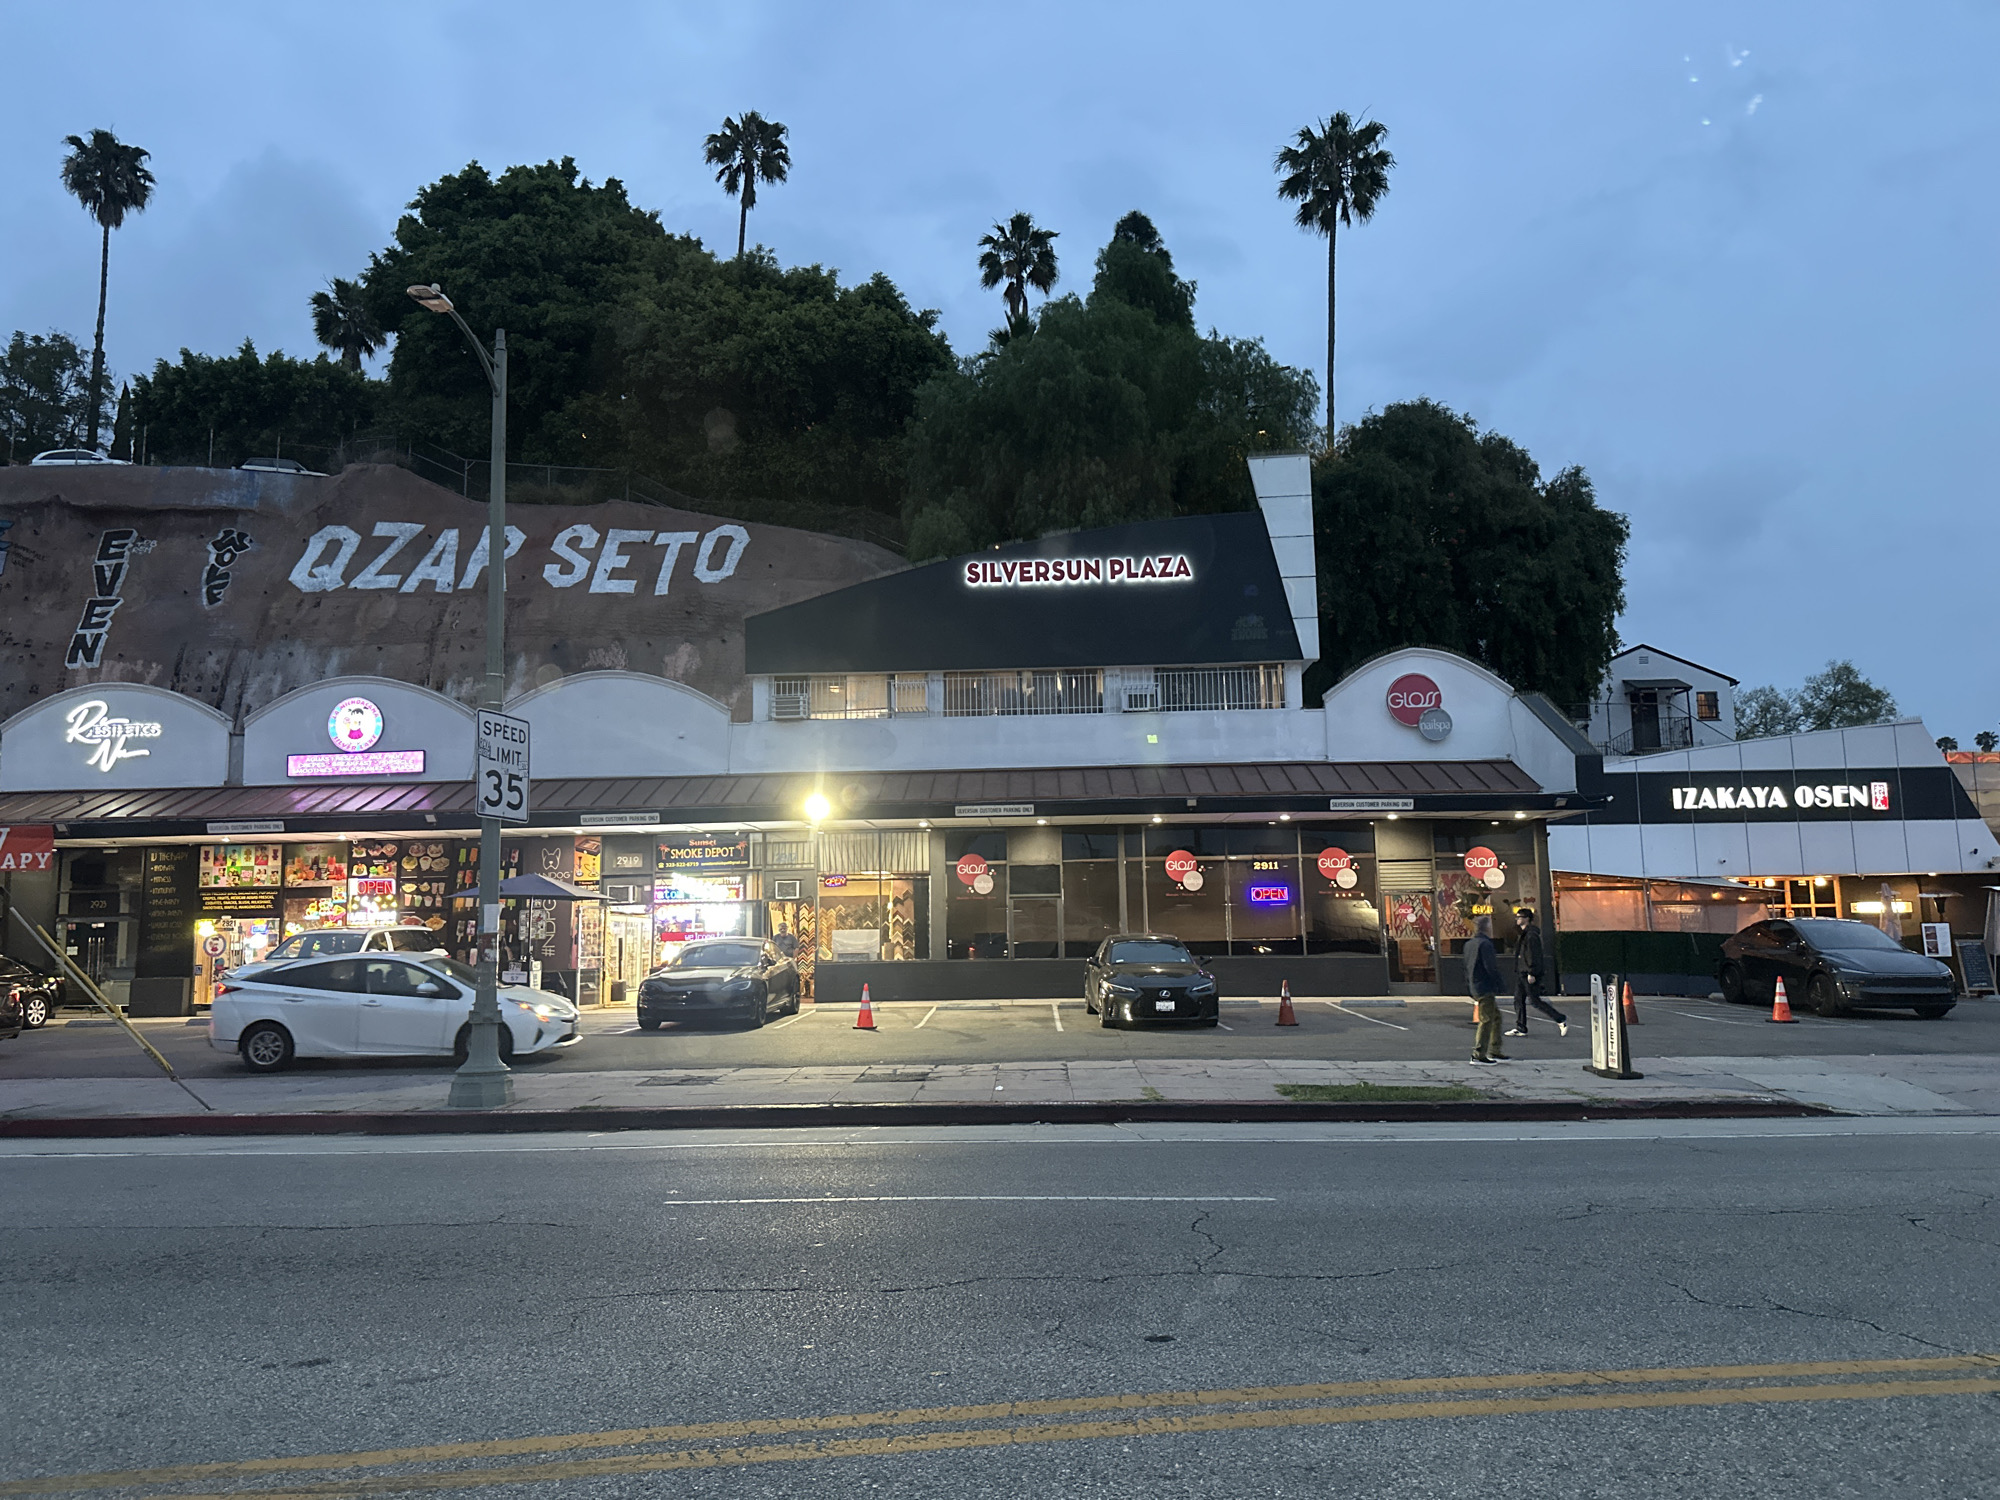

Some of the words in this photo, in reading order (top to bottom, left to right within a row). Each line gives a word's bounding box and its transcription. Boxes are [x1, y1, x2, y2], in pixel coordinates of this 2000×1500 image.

[543, 524, 751, 596] SETO
[965, 559, 1101, 584] SILVERSUN
[1109, 556, 1191, 580] PLAZA
[66, 529, 138, 669] EVEN
[1388, 691, 1440, 708] GLOSS
[483, 721, 526, 744] SPEED
[1420, 719, 1451, 732] nailspa
[489, 746, 522, 766] LIMIT
[483, 769, 523, 811] 35
[1672, 786, 1788, 810] IZAKAYA
[1794, 785, 1868, 808] OSEN
[616, 856, 640, 865] 2919
[670, 848, 704, 859] SMOKE
[705, 847, 735, 858] DEPOT
[957, 863, 987, 874] GLOSS
[1166, 860, 1197, 870] GLOSS
[1253, 861, 1279, 870] 2911
[1318, 857, 1350, 868] GLOSS
[1465, 857, 1497, 868] GLOSS
[357, 880, 394, 895] OPEN
[1253, 888, 1287, 901] OPEN
[1608, 1002, 1616, 1050] VALET
